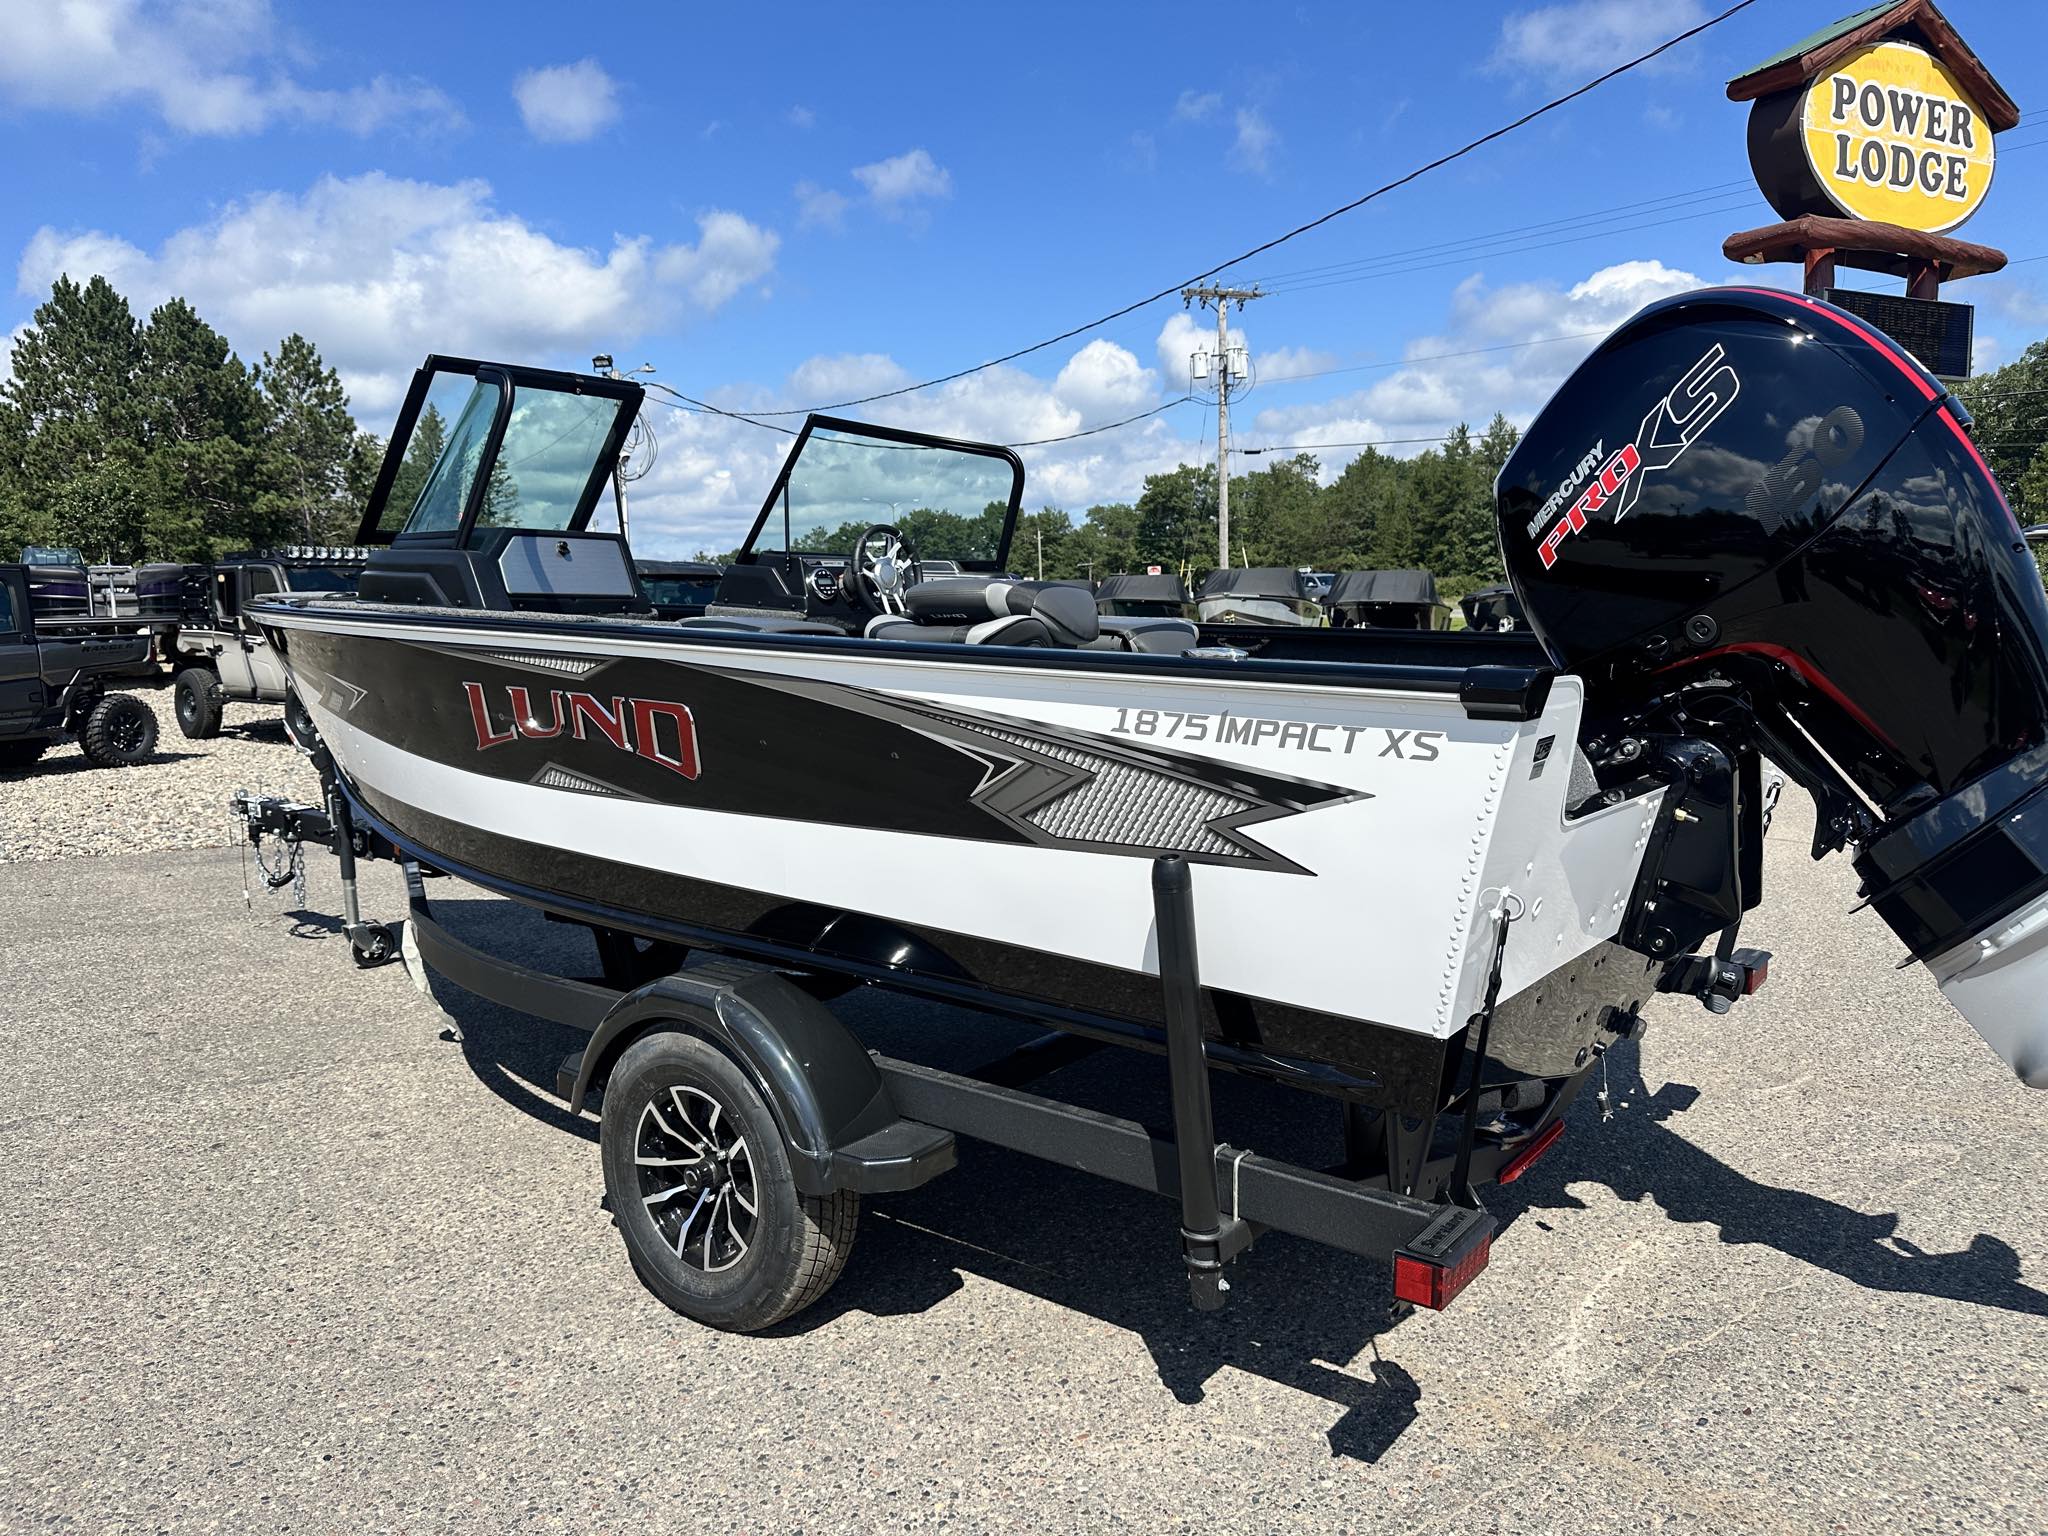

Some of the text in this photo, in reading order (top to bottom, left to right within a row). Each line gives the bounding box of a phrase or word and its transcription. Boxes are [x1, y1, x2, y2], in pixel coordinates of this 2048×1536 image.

[1831, 76, 1974, 149] POWER
[1835, 133, 1968, 199] LODGE
[1526, 438, 1606, 539] MERCURY
[1537, 443, 1642, 571] PRO
[462, 681, 702, 781] LUND
[1110, 707, 1449, 762] 1875 IMPACT XS
